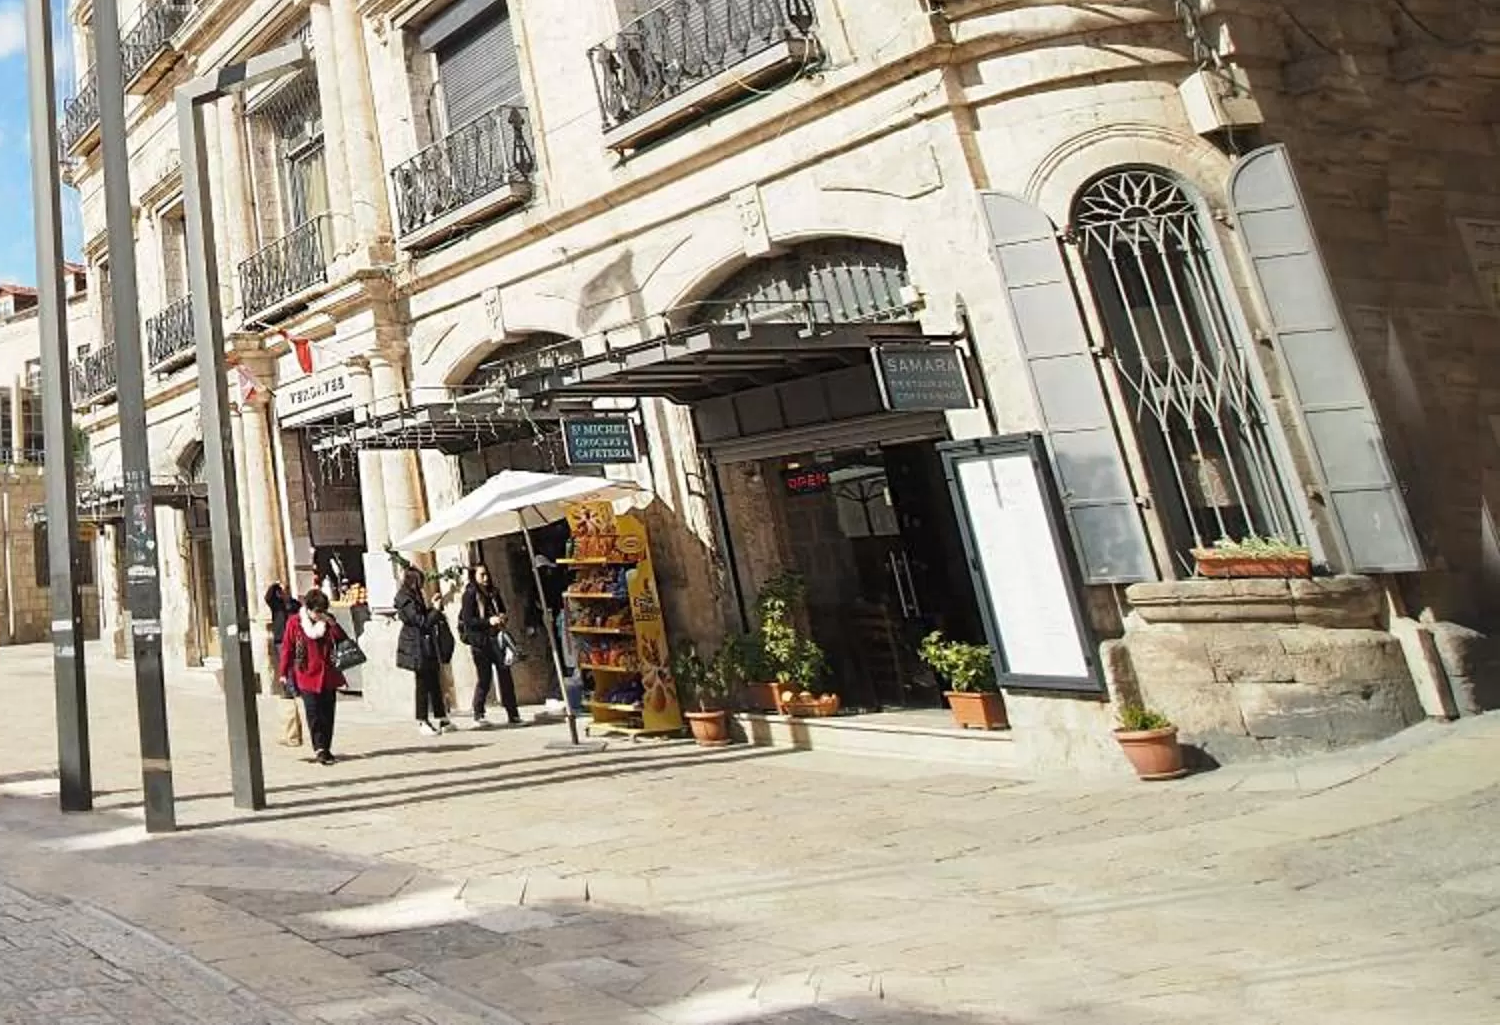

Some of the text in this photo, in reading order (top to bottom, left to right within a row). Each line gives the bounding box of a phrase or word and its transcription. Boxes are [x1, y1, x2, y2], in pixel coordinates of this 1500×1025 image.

[887, 358, 956, 372] SAMARA
[583, 424, 629, 435] MICHEL
[575, 448, 633, 459] CAFETERIA
[786, 473, 827, 489] OPEN
